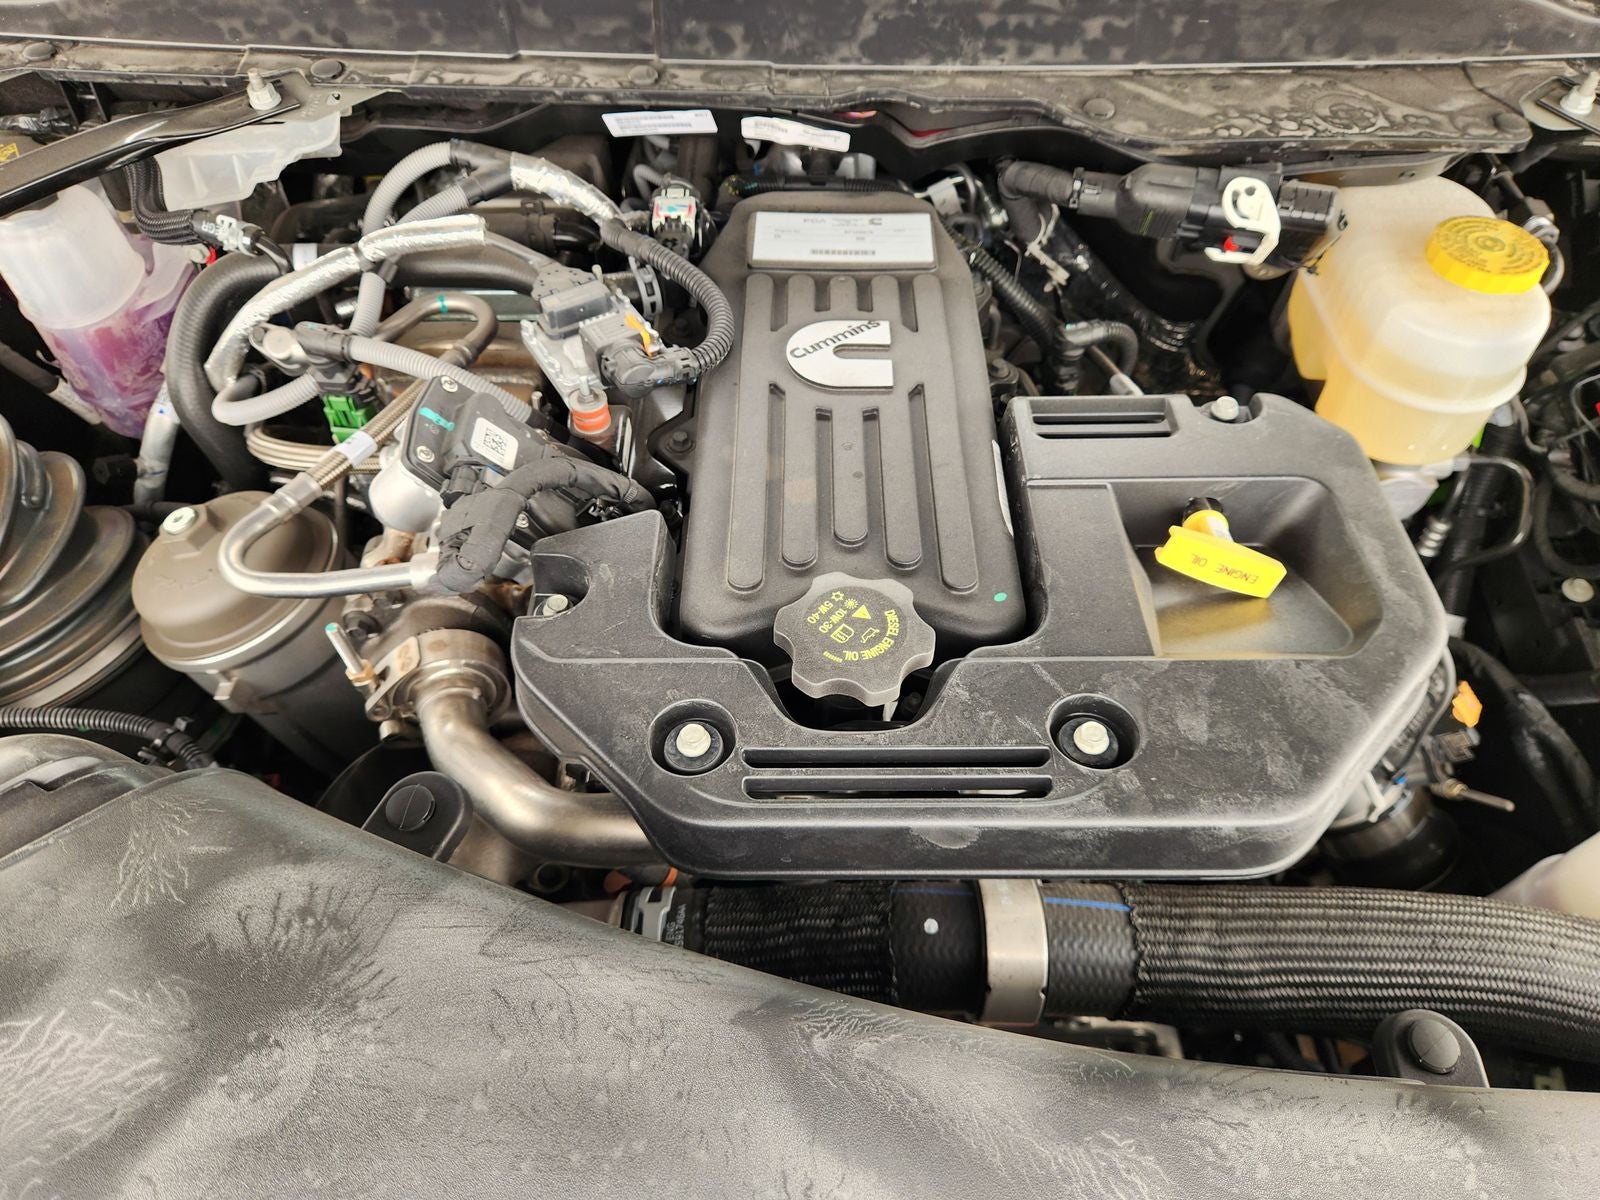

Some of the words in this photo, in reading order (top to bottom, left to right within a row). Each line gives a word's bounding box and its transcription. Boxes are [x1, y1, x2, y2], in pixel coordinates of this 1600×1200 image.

[790, 320, 880, 358] Cummins
[1215, 563, 1259, 584] ENGINE
[807, 600, 833, 624] 5W-40
[818, 608, 848, 634] 10W-30
[884, 609, 899, 636] DIESEL
[843, 650, 859, 661] OIL
[861, 637, 895, 660] ENGINE
